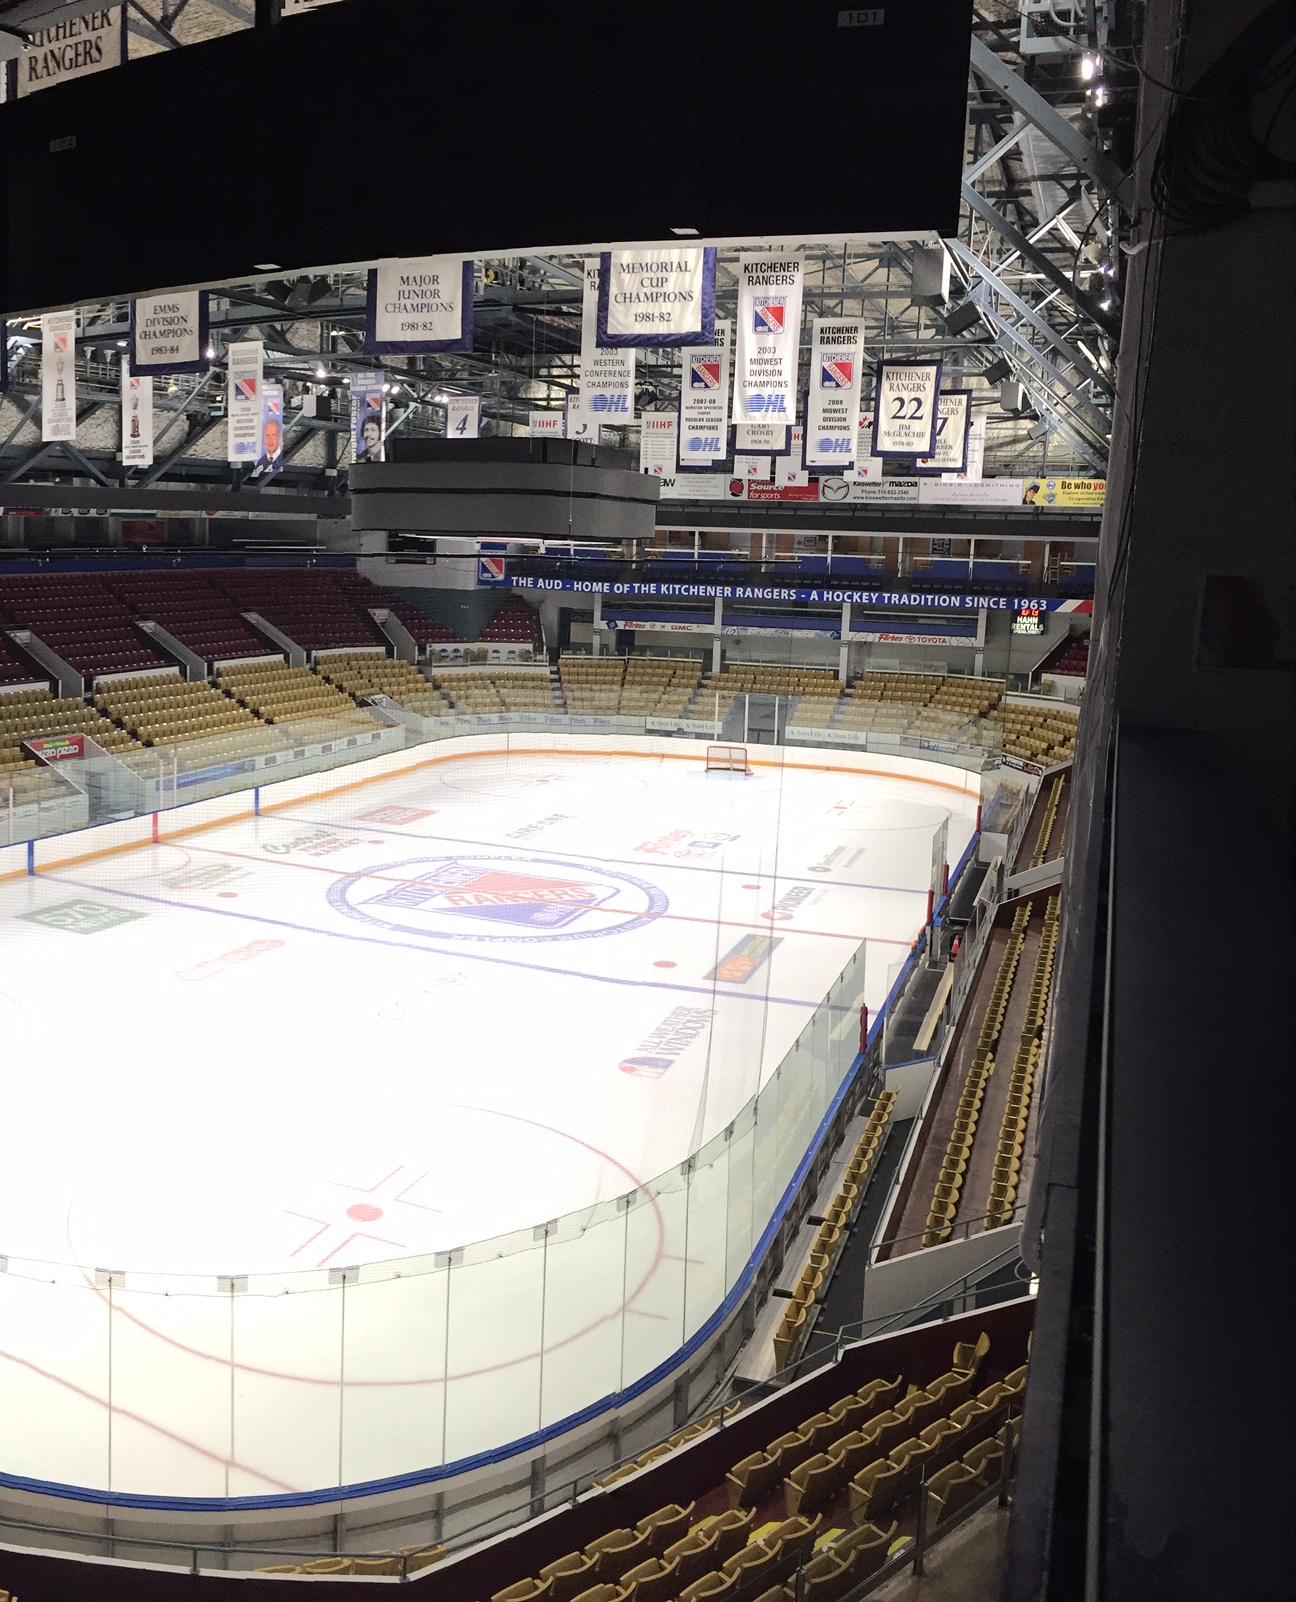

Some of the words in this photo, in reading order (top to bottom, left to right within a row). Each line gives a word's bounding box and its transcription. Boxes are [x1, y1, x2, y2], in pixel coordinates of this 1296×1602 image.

[28, 36, 102, 82] RANGERS
[619, 261, 692, 274] MEMORIAL
[744, 262, 800, 273] KITCHENER
[400, 275, 440, 287] MAJOR
[640, 277, 668, 288] CUP
[748, 275, 795, 286] RANGERS
[398, 289, 441, 301] JUNIOR
[614, 291, 694, 304] CHAMPIONS
[153, 304, 180, 315] EMMS
[385, 302, 454, 314] CHAMPIONS
[145, 315, 189, 328] DIVISION
[634, 312, 672, 323] 1981-82
[759, 307, 781, 332] RANGERS
[401, 322, 434, 332] 1981-82
[820, 326, 859, 335] KITCHENER
[139, 327, 194, 340] CHAMPIONS
[820, 335, 858, 345] RANGERS
[757, 346, 777, 354] 2003
[593, 359, 625, 367] WESTERN
[749, 358, 783, 366] MIDWEST
[749, 369, 783, 377] DIVISION
[826, 362, 849, 388] RANGERS
[885, 371, 931, 381] KITCHENER
[742, 380, 789, 388] CHAMPIONS
[889, 382, 926, 392] RANGERS
[588, 394, 629, 412] OHL
[745, 394, 787, 412] OHL
[939, 398, 963, 406] HENER
[890, 396, 925, 420] 22
[455, 414, 469, 435] 4
[538, 420, 558, 428] IIHF
[652, 421, 673, 429] IIHF
[815, 438, 852, 453] OHL
[1061, 481, 1072, 489] Be
[1074, 481, 1091, 489] who
[1093, 482, 1106, 490] yo
[749, 490, 759, 499] for
[760, 491, 781, 500] sports
[511, 576, 534, 587] THE
[537, 578, 563, 590] AUD
[574, 581, 610, 593] HOME
[614, 583, 630, 594] OF
[633, 583, 657, 594] THE
[661, 584, 732, 597] KITCHENER
[736, 587, 797, 600] RANGERS
[810, 590, 819, 601] A
[823, 591, 880, 603] HOCKEY
[883, 593, 960, 607] TRADITION
[965, 596, 1007, 609] SINCE
[1014, 598, 1047, 610] 1963
[1012, 623, 1044, 631] RENTALS
[917, 636, 947, 644] TOYOTA
[56, 745, 78, 759] pizza
[443, 887, 598, 907] RANGERS
[775, 886, 816, 913] PIONEER
[34, 903, 109, 926] 570
